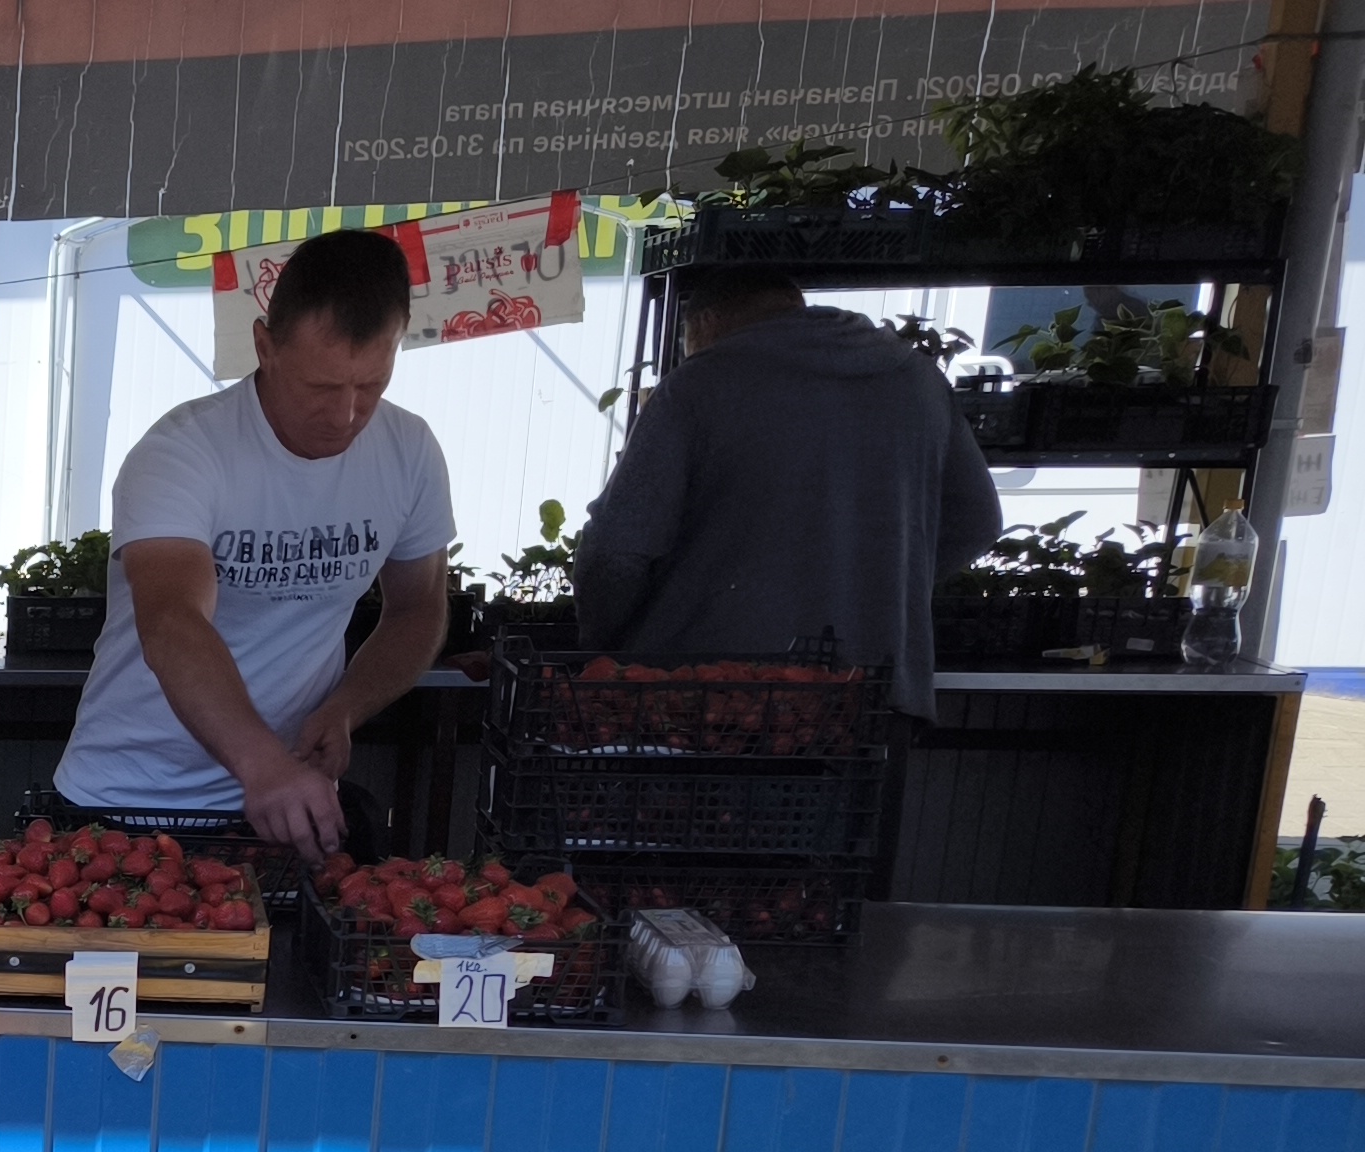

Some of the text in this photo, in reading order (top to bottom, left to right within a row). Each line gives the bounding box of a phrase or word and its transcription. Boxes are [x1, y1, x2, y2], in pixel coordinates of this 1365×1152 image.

[297, 561, 342, 579] CLUB
[89, 986, 129, 1033] 16
[452, 974, 506, 1024] 20
